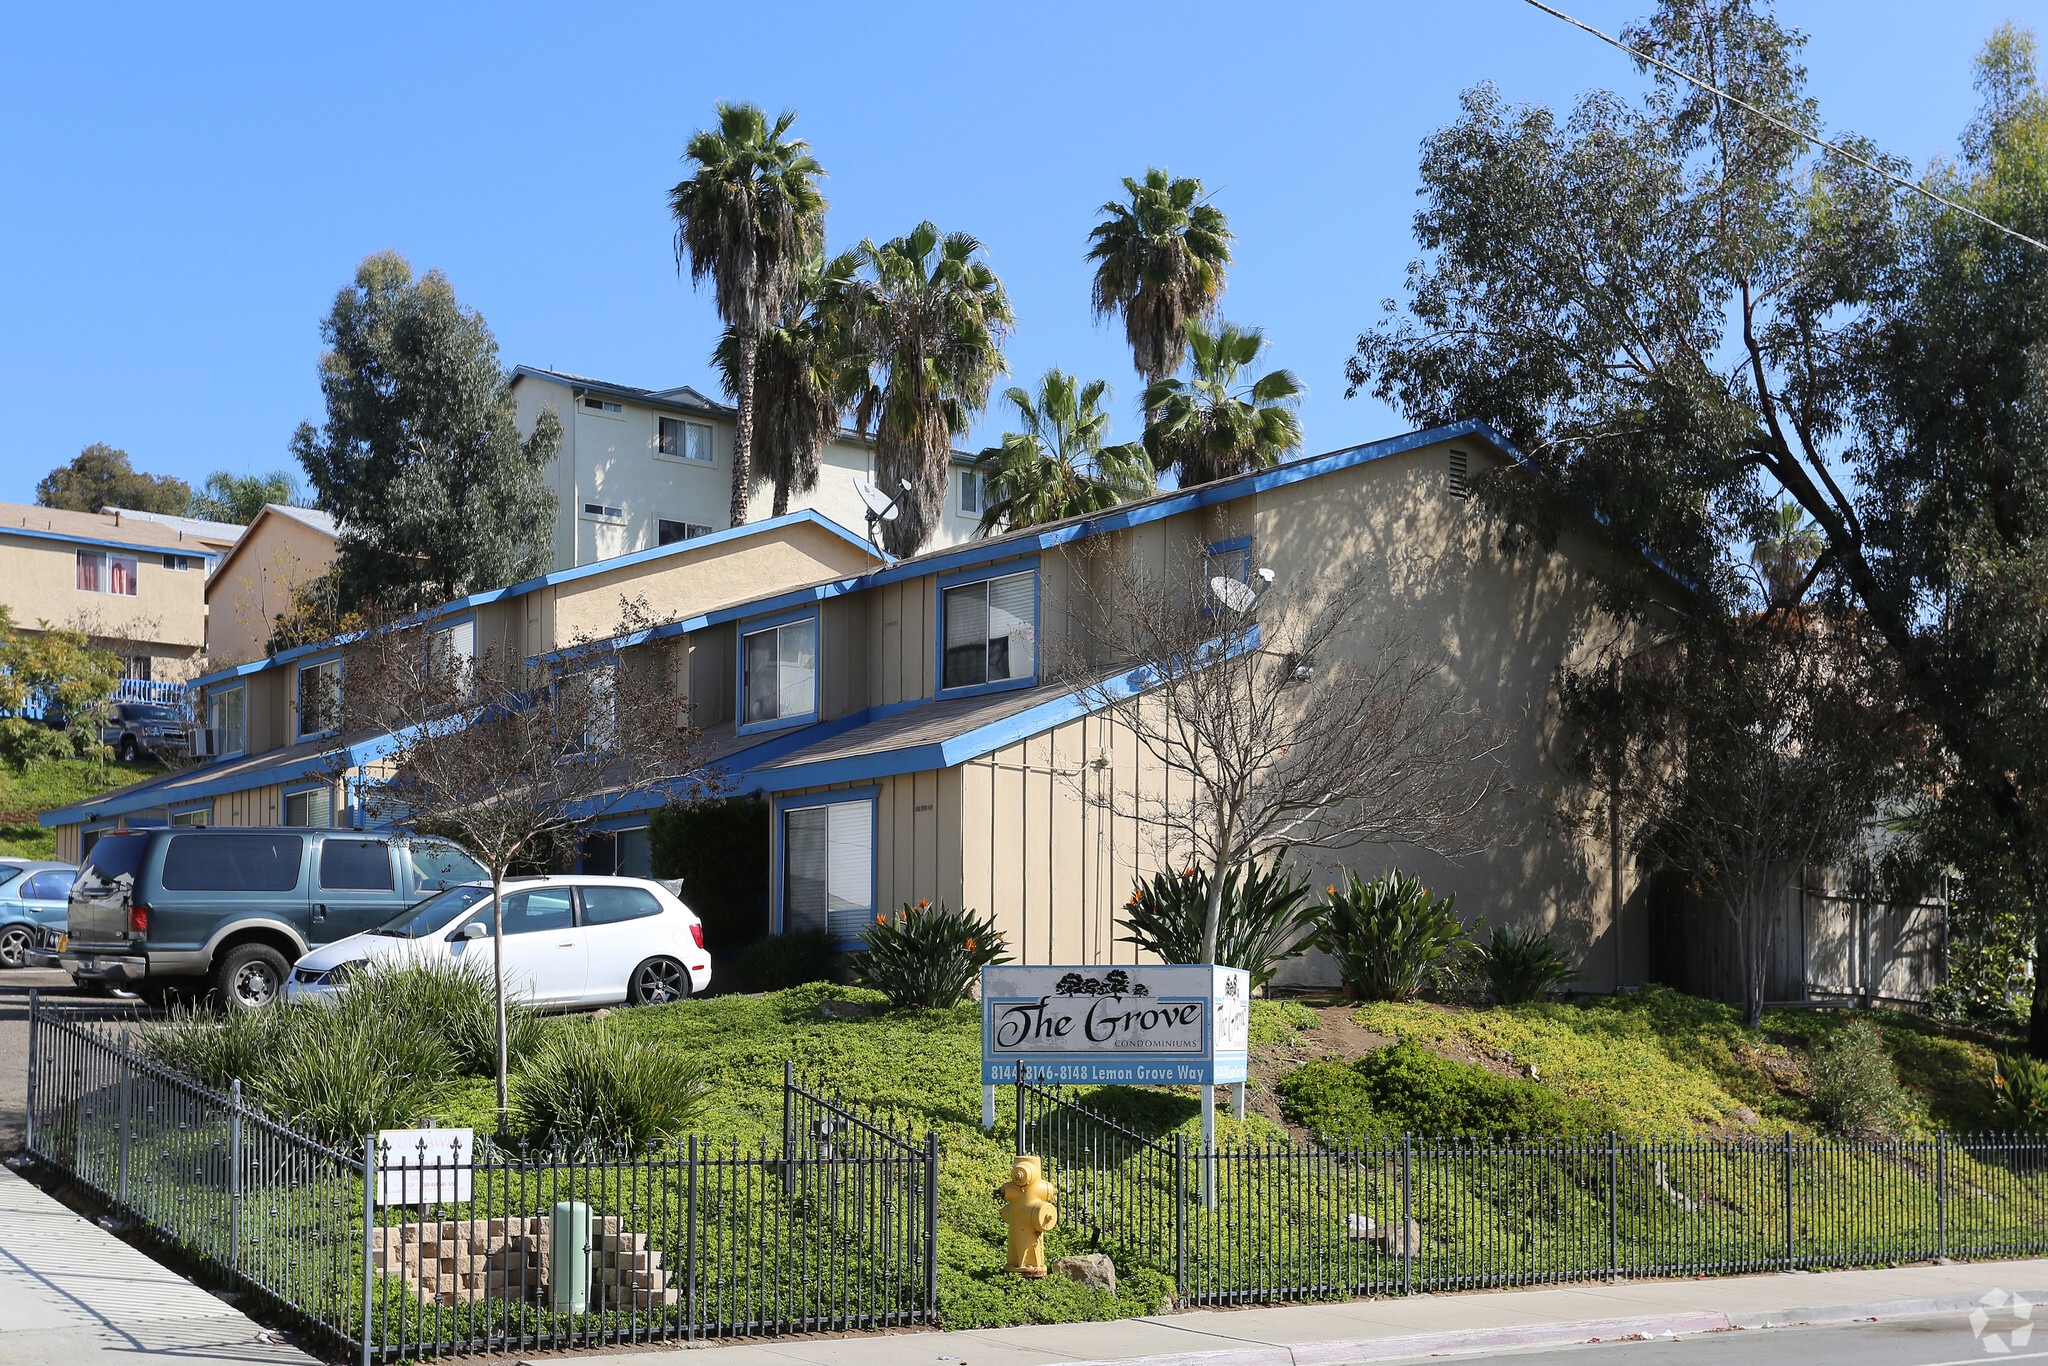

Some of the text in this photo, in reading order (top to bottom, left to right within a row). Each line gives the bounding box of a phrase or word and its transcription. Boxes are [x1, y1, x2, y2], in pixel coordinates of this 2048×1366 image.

[997, 995, 1201, 1047] The Grove
[1114, 1040, 1197, 1048] CONDOMINIUMS
[991, 1065, 1088, 1080] 81448146-8148
[1092, 1065, 1132, 1080] Lemon
[1137, 1065, 1173, 1080] Grove
[1177, 1065, 1204, 1082] Way
